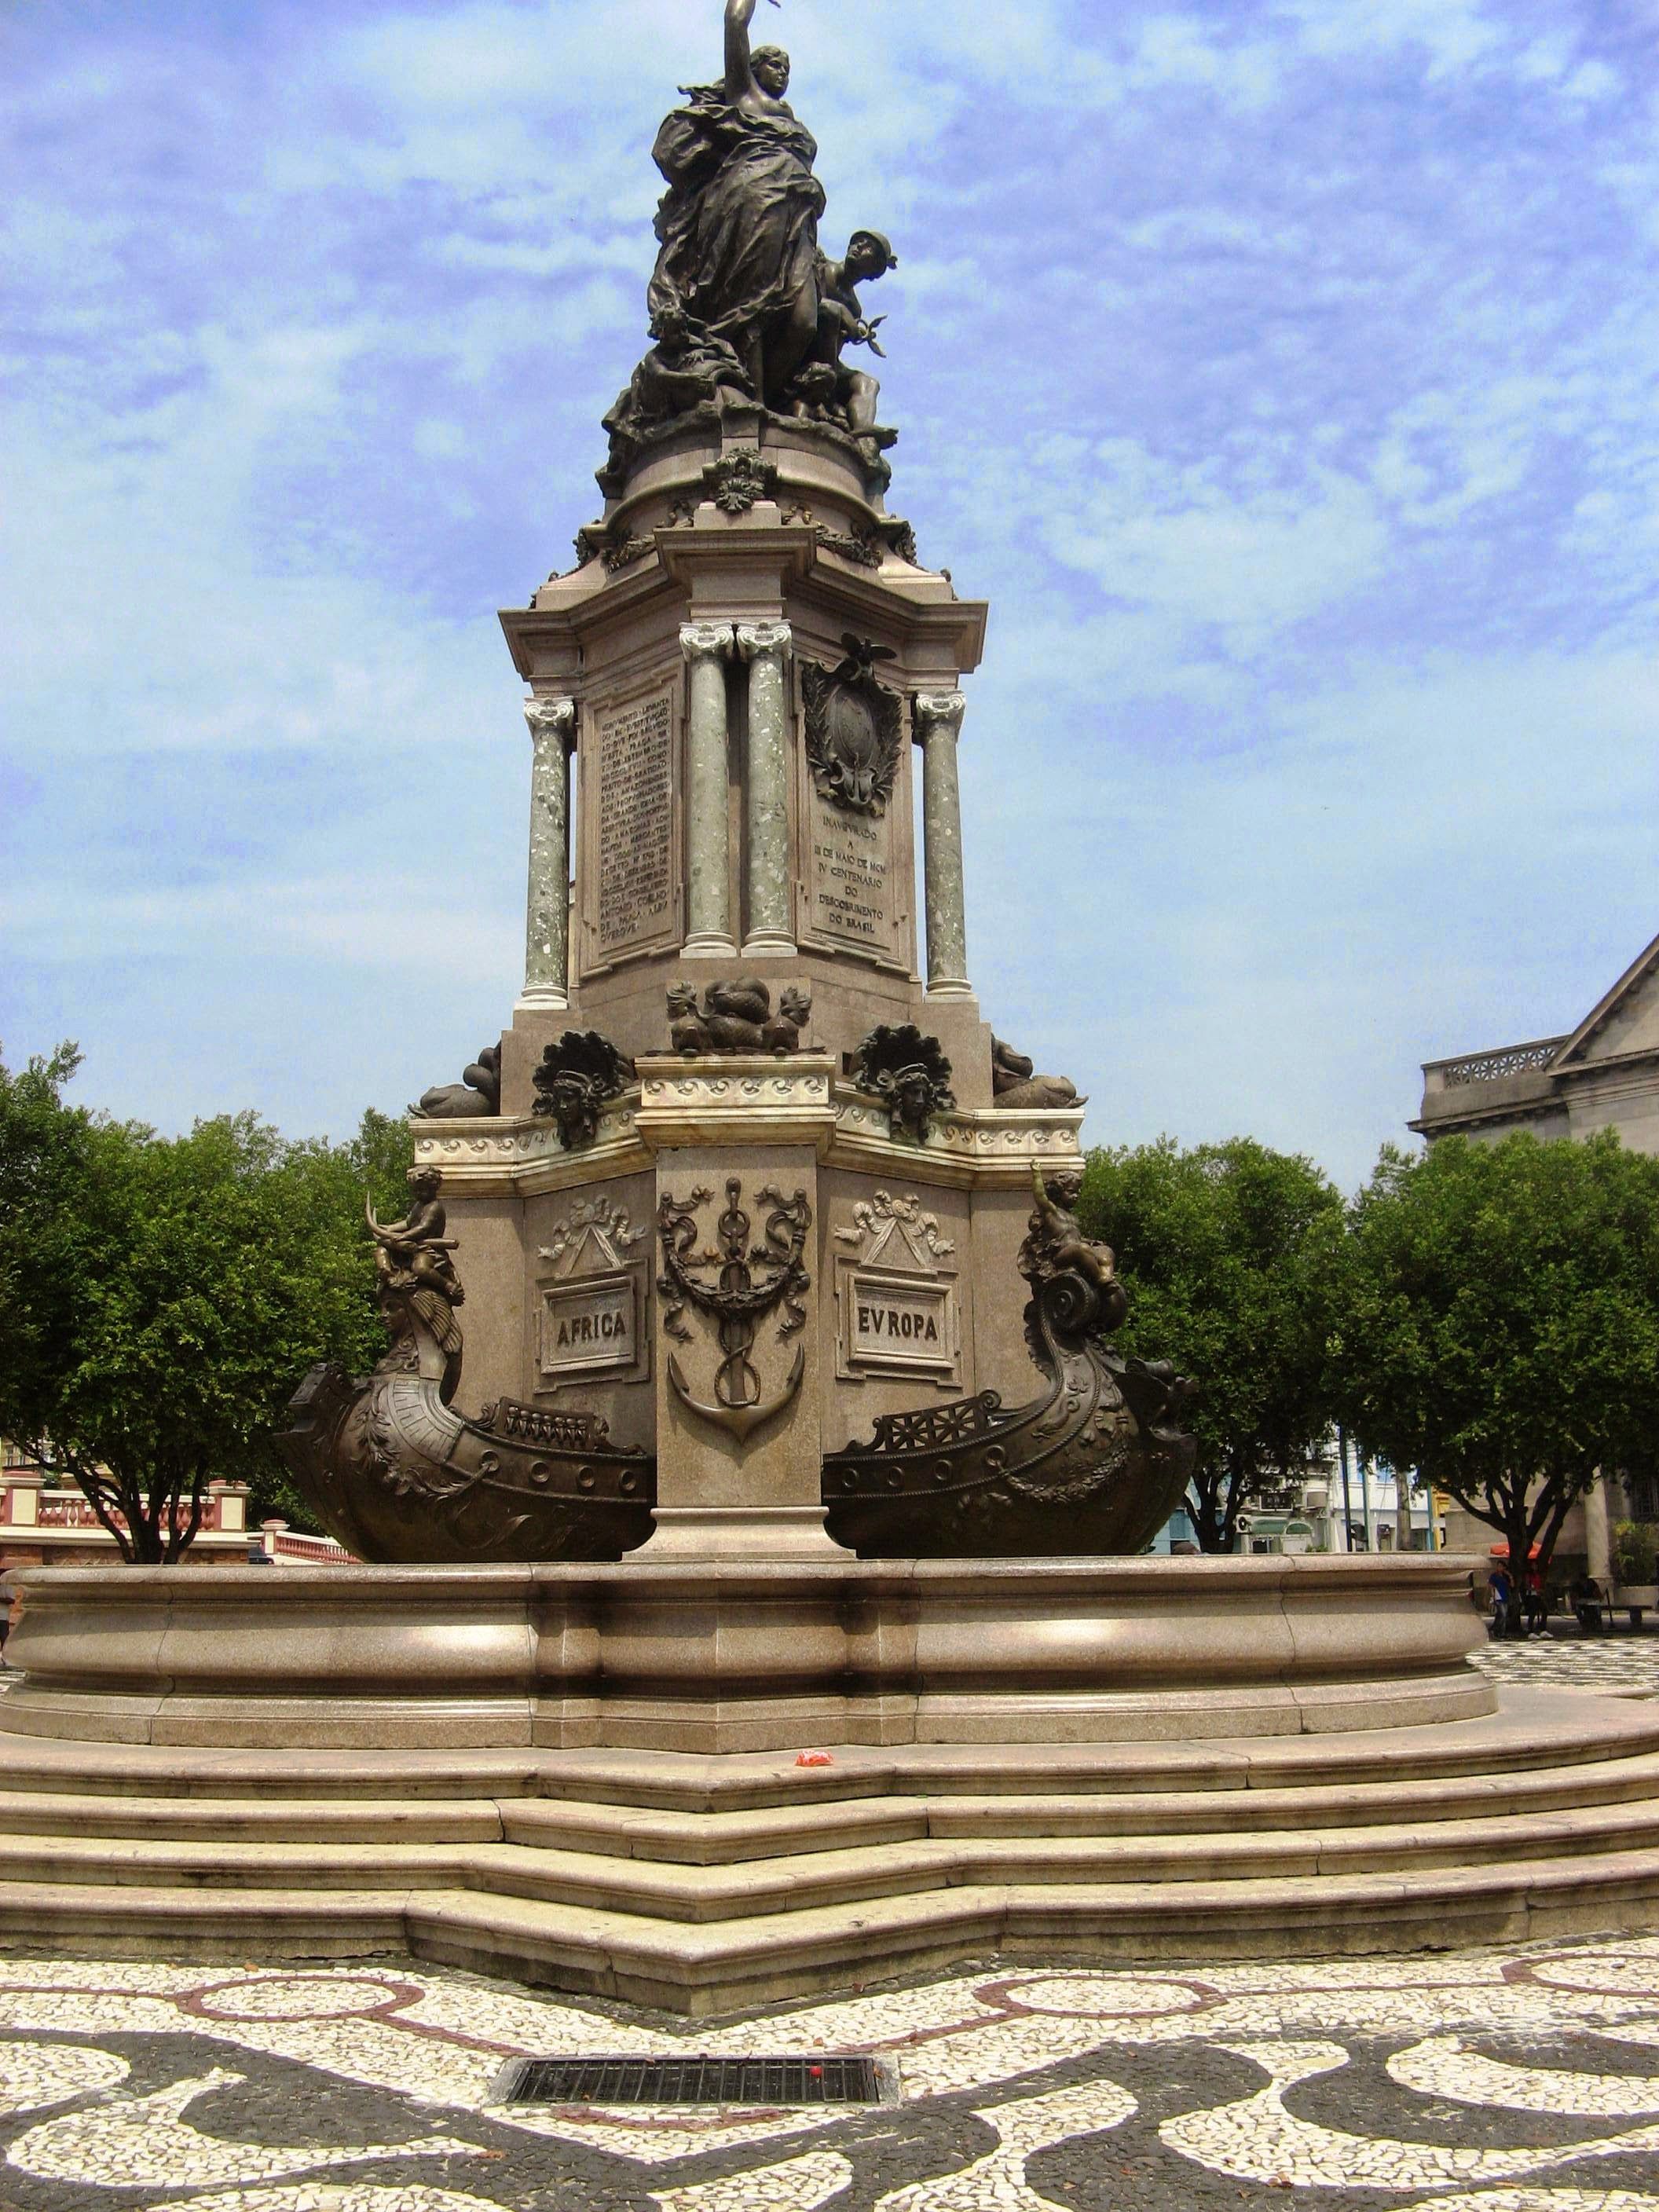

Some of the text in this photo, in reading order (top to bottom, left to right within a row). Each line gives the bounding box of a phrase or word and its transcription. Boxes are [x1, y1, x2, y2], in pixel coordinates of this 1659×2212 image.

[848, 840, 853, 850] A
[823, 848, 833, 859] DE
[835, 850, 855, 865] MAIO
[857, 858, 868, 869] DE
[845, 886, 858, 896] DO
[819, 894, 883, 920] DESCOBRIMENTO
[830, 913, 874, 933] DO BRASIL
[557, 1311, 627, 1347] AFRICA
[858, 1306, 938, 1341] EVROPA
